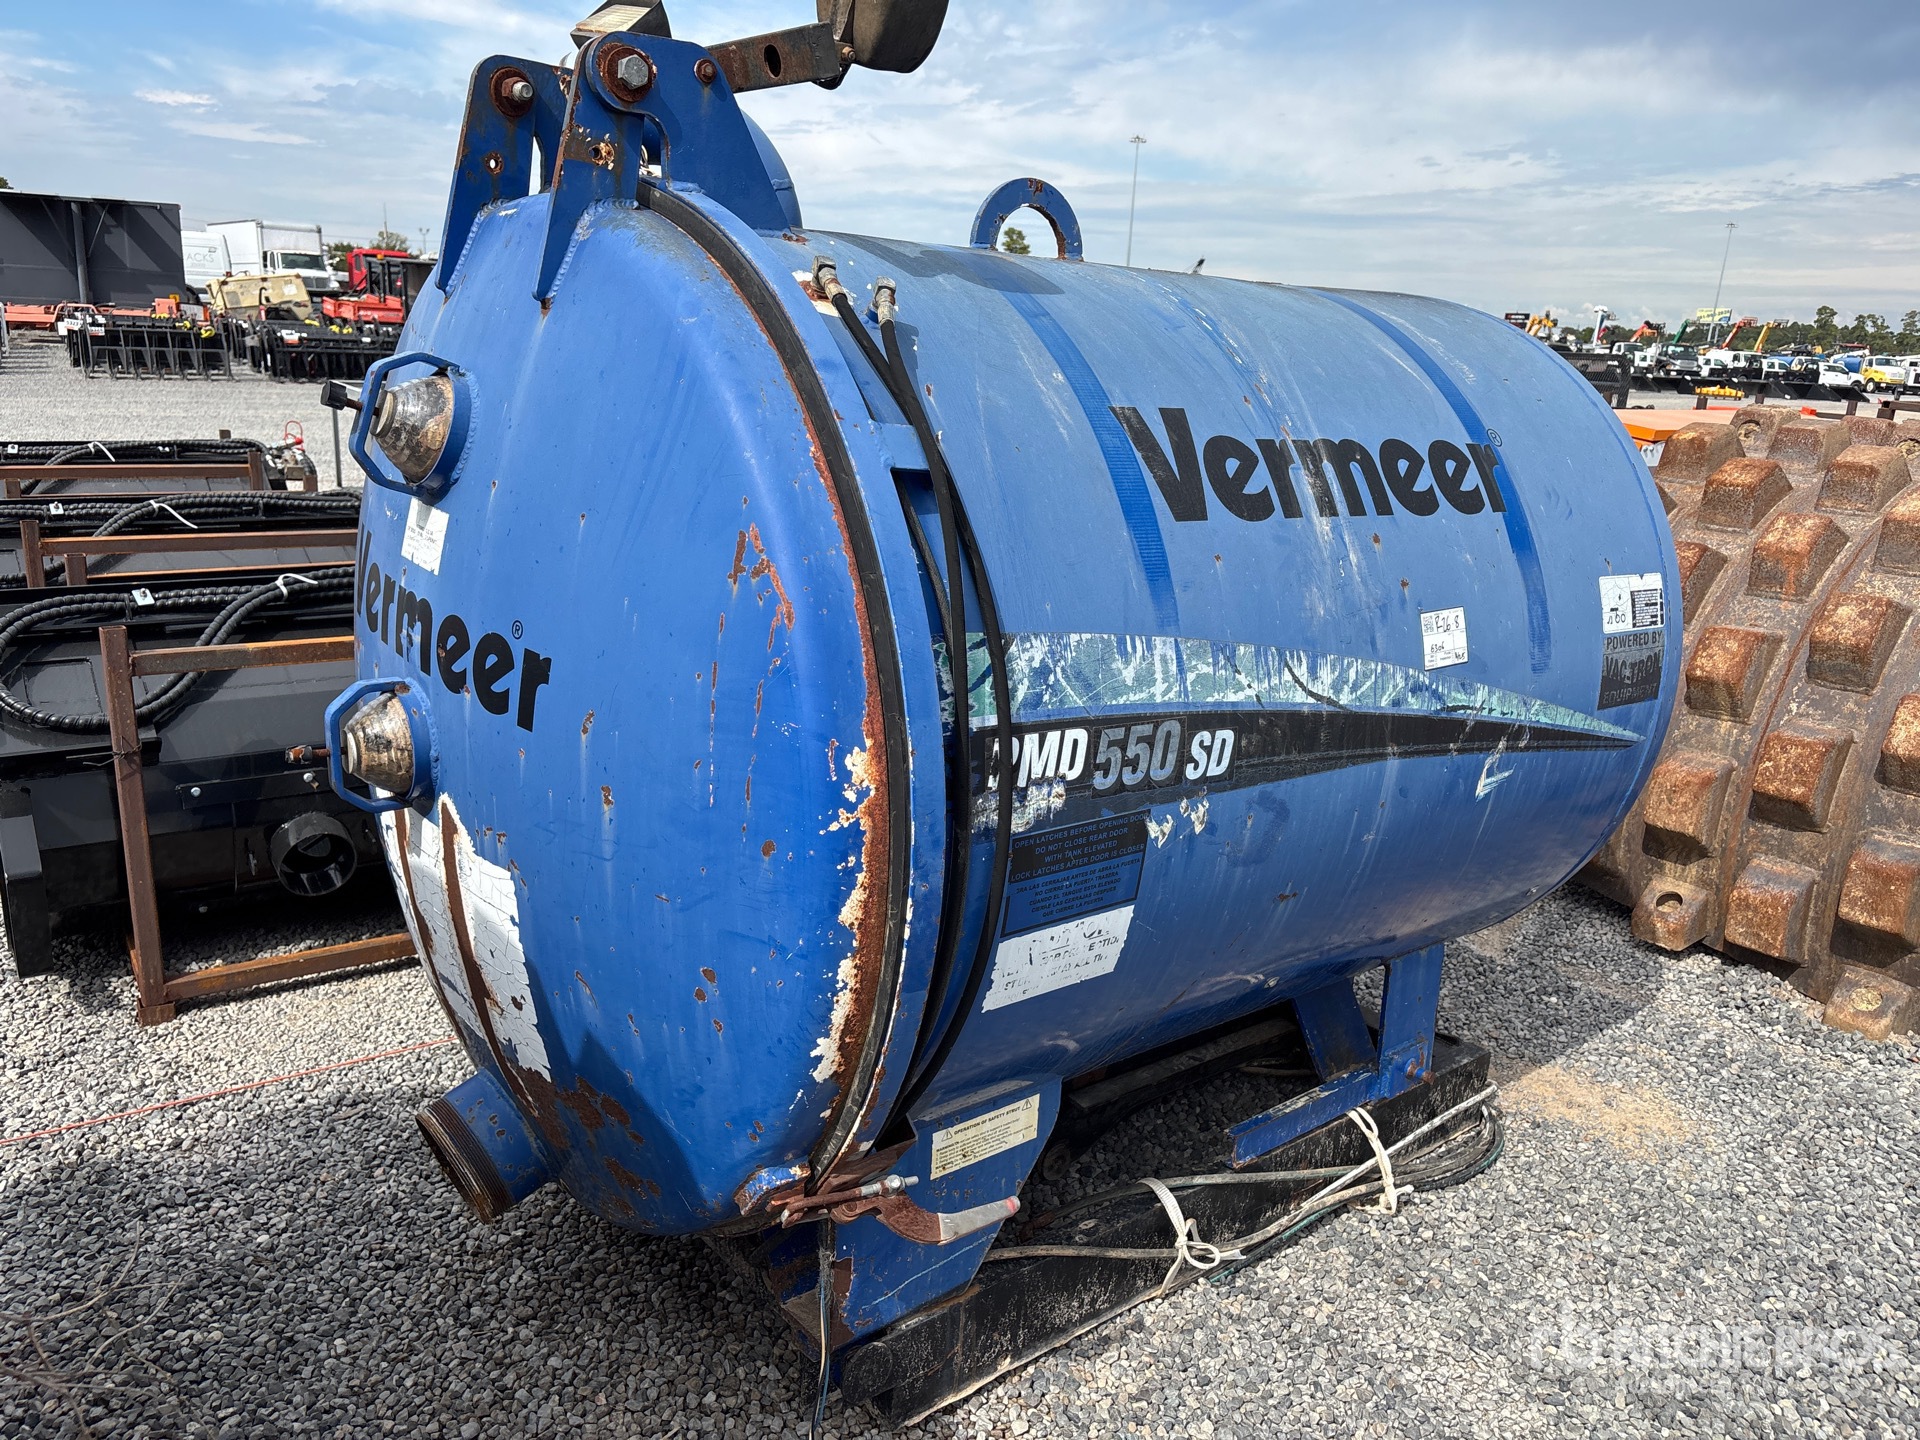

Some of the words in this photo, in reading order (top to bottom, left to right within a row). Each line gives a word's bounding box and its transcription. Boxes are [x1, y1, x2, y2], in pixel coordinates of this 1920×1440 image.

[1108, 405, 1507, 522] Vermeer
[1606, 634, 1650, 651] POWERED
[1651, 631, 1663, 645] BY
[1093, 719, 1182, 791] 550
[1185, 728, 1236, 780] SD
[1035, 846, 1045, 854] DO
[1048, 842, 1062, 851] NOT
[1064, 836, 1087, 847] CLOSE
[1089, 832, 1107, 842] REAR
[1108, 827, 1128, 837] DOOR
[1036, 830, 1067, 843] LATCHES
[1070, 824, 1097, 836] BEFORE
[1098, 818, 1127, 830] OPENING
[1044, 852, 1062, 862] WITH
[1064, 848, 1082, 857] TANK
[1084, 840, 1117, 853] ELEVATED
[1032, 862, 1064, 875] LATCHES
[1066, 856, 1089, 867] AFTER
[1090, 852, 1109, 862] DOOR
[954, 1121, 980, 1134] OPERATION
[988, 1112, 1004, 1121] SAFETY
